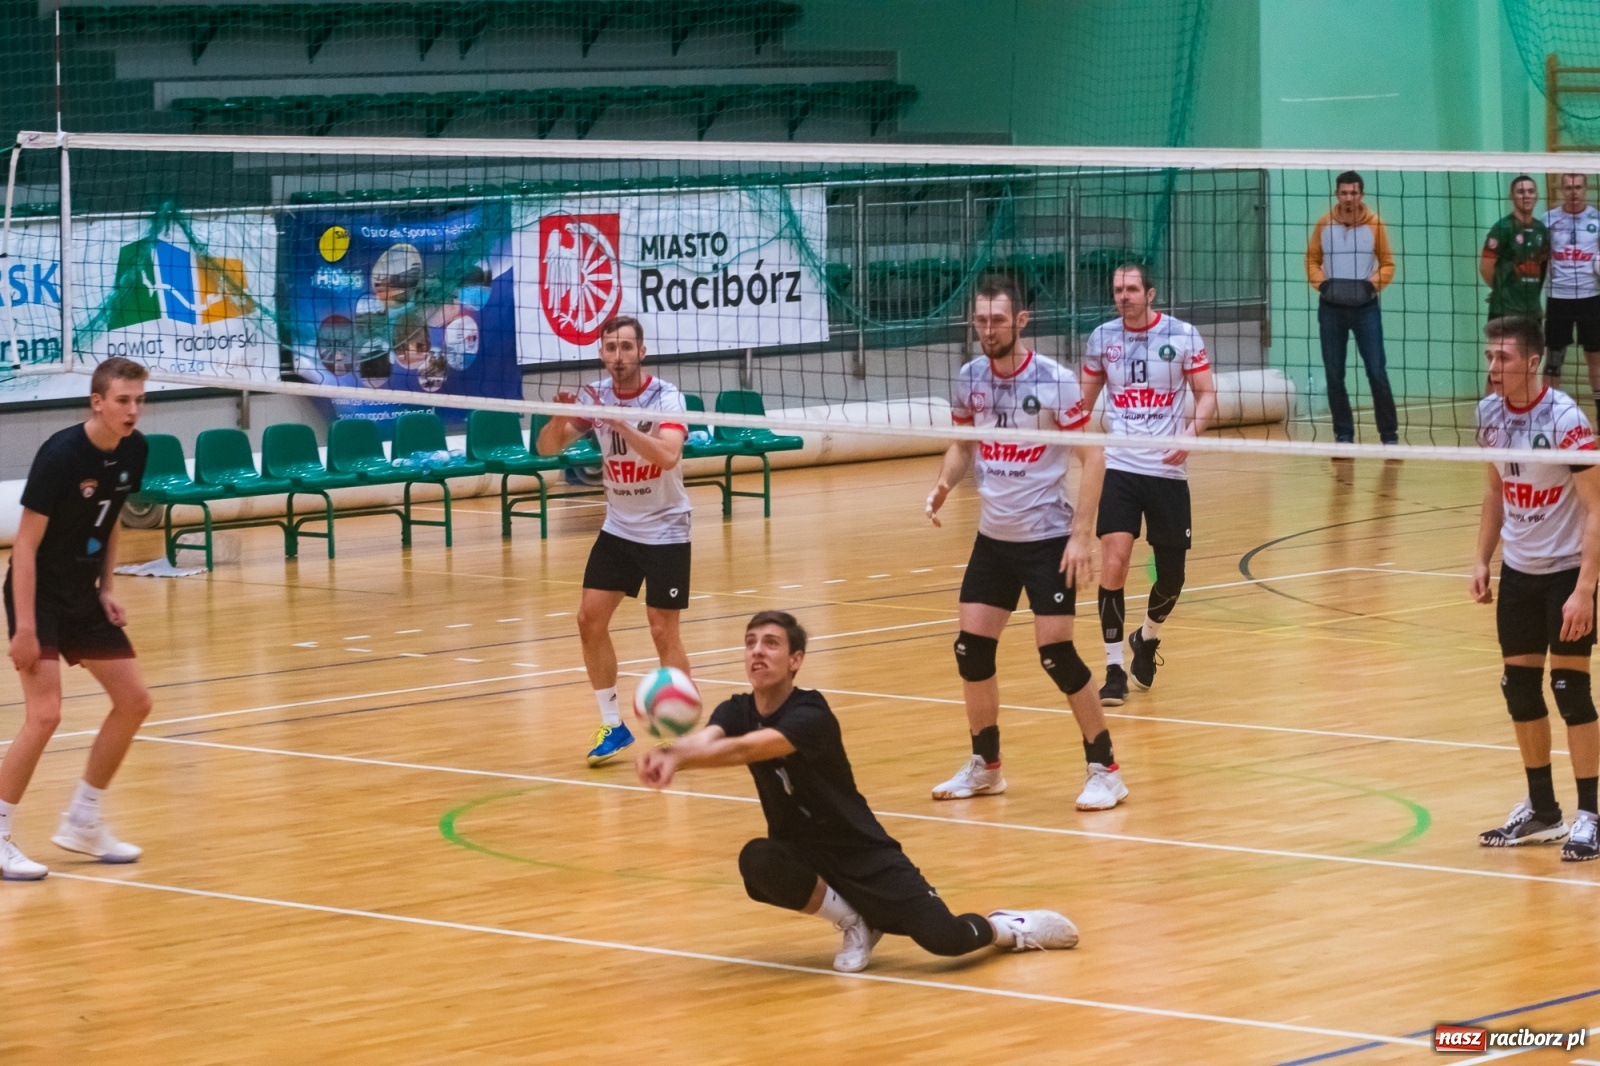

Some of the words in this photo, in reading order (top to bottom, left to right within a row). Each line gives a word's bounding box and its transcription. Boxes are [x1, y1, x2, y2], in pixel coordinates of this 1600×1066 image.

[640, 231, 728, 261] MIASTO
[639, 258, 802, 313] Racibórz
[1131, 359, 1147, 384] 13
[605, 460, 663, 484] FAKO
[1503, 481, 1565, 509] FAKO
[94, 499, 112, 527] 7
